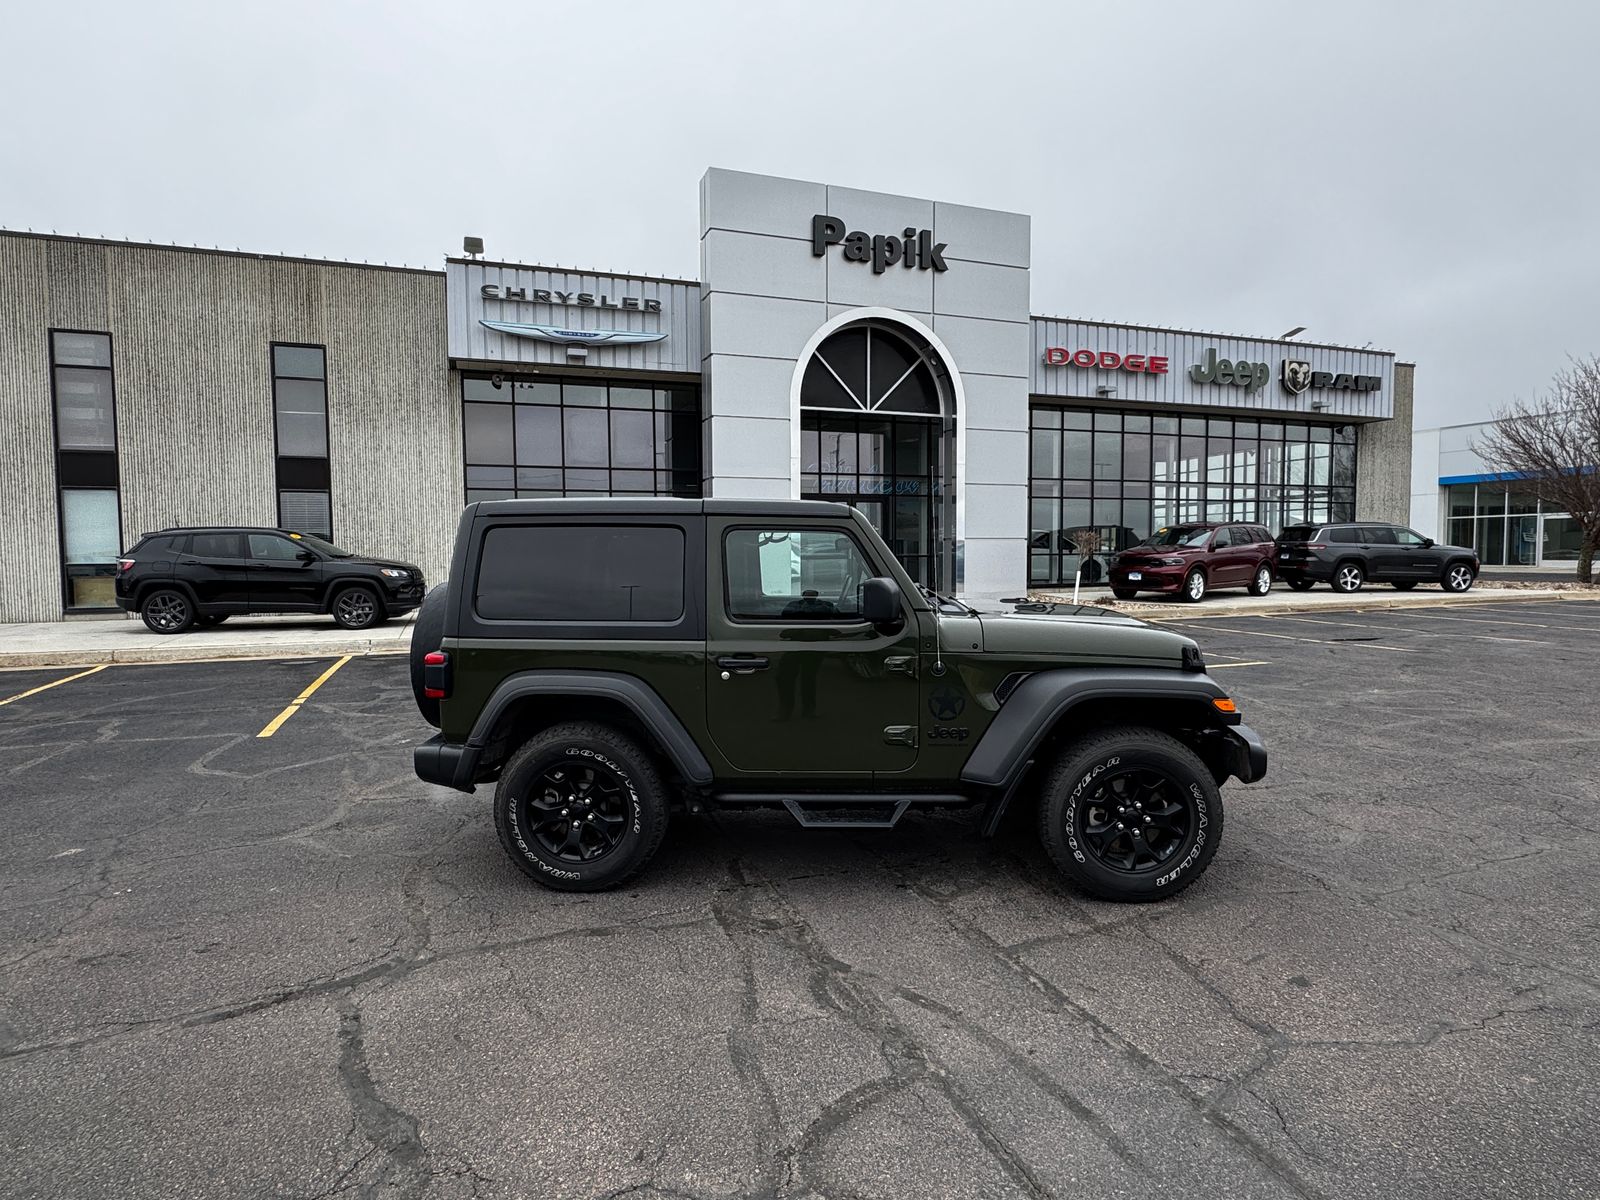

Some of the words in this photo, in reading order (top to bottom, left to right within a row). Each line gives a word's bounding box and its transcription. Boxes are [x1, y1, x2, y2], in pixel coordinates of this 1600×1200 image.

[812, 214, 949, 274] Papik
[480, 284, 663, 313] CHRYSLER
[1044, 347, 1169, 375] DODGE
[1189, 347, 1270, 394] Jeep
[1311, 371, 1382, 392] RAM
[927, 724, 970, 741] Jeep
[565, 748, 642, 834] GOODYEAR
[1066, 756, 1121, 863] GOODYEAR
[509, 797, 581, 881] WRANGLER
[1156, 783, 1208, 887] WRANGLER
